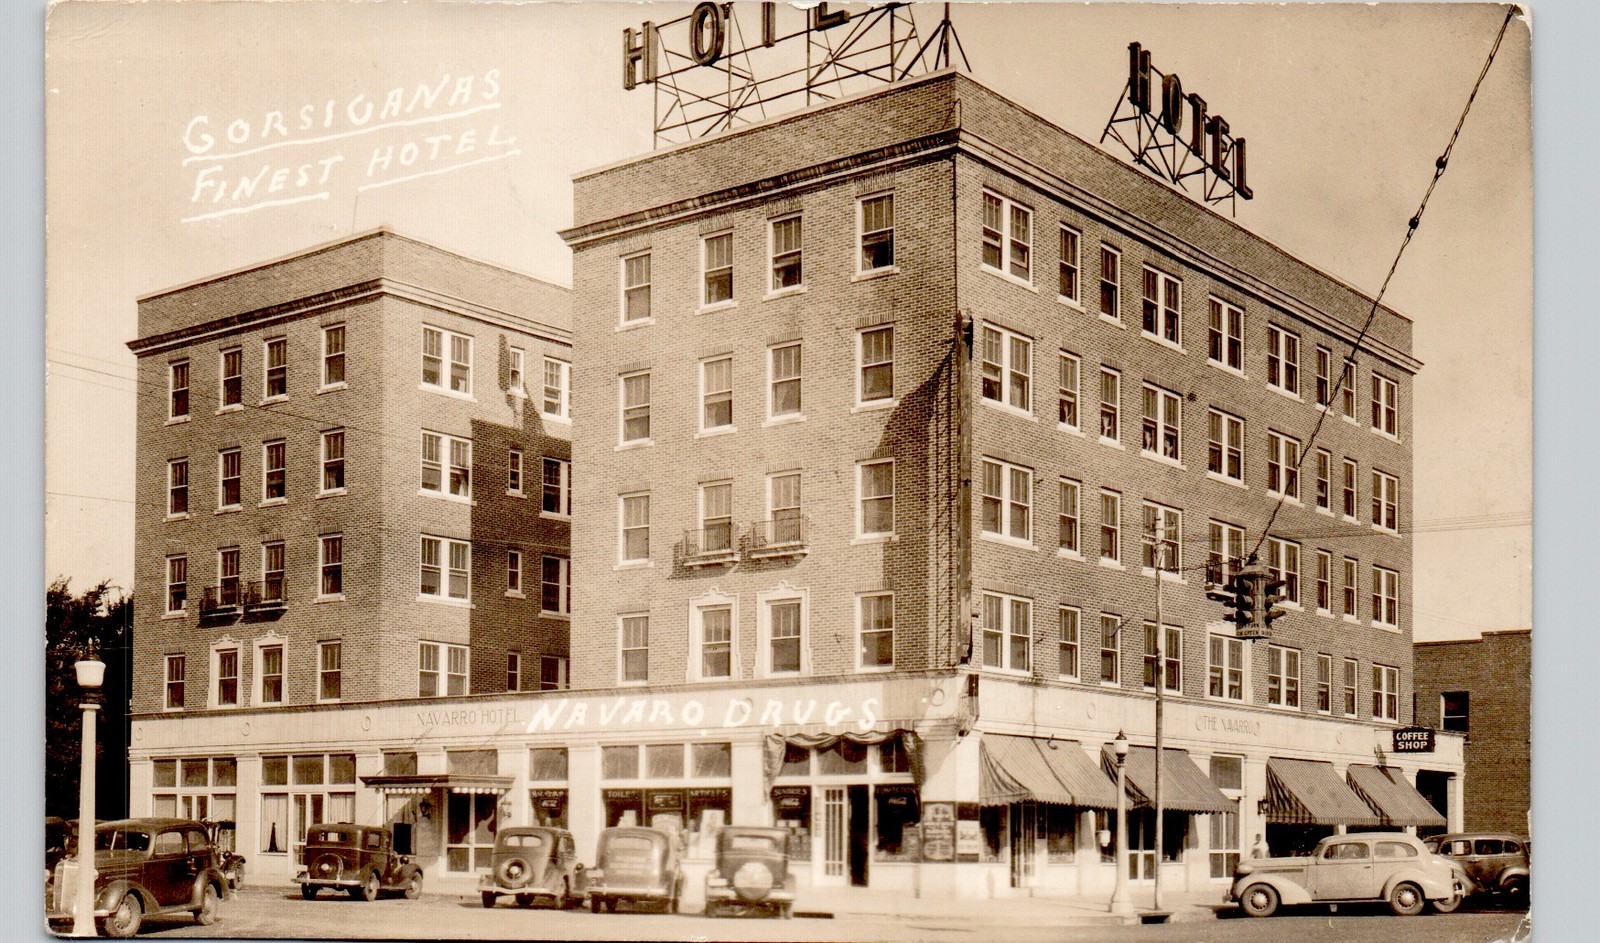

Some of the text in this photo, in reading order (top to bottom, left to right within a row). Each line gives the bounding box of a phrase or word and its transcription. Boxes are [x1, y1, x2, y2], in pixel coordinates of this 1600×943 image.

[1128, 42, 1253, 200] HOTEL
[417, 709, 521, 726] NAVARRO HOTEL
[1203, 715, 1217, 731] THE
[1396, 731, 1429, 741] COFFEE
[1398, 741, 1428, 750] SHOP
